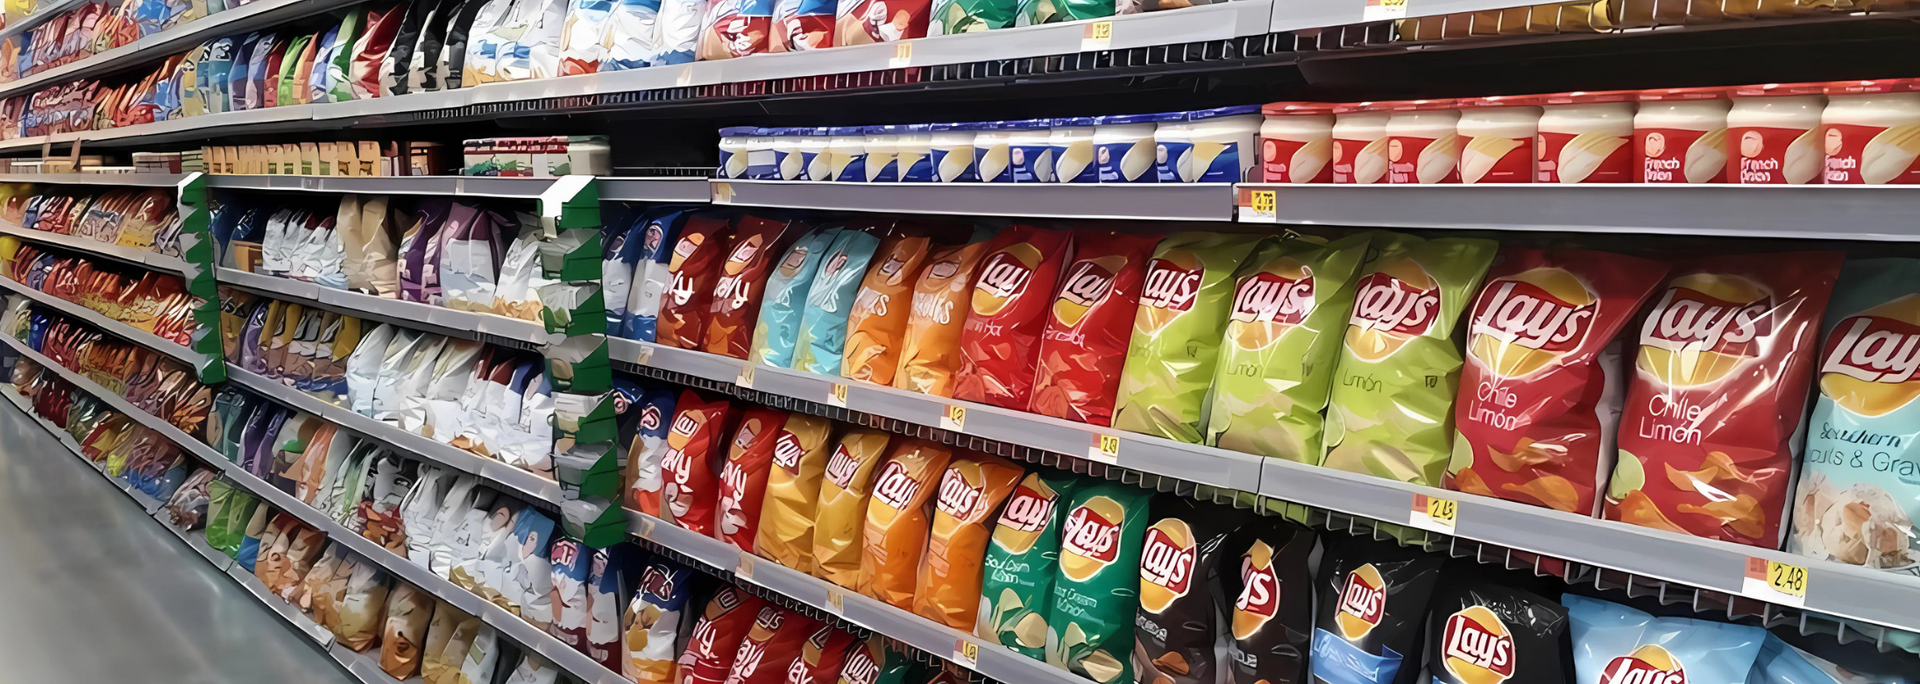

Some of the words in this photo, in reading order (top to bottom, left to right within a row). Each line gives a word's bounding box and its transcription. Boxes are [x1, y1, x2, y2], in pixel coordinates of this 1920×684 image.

[1472, 282, 1592, 349] Lay's
[1849, 449, 1863, 468] &
[1872, 451, 1920, 476] Gra
[1447, 615, 1511, 670] Lay's
